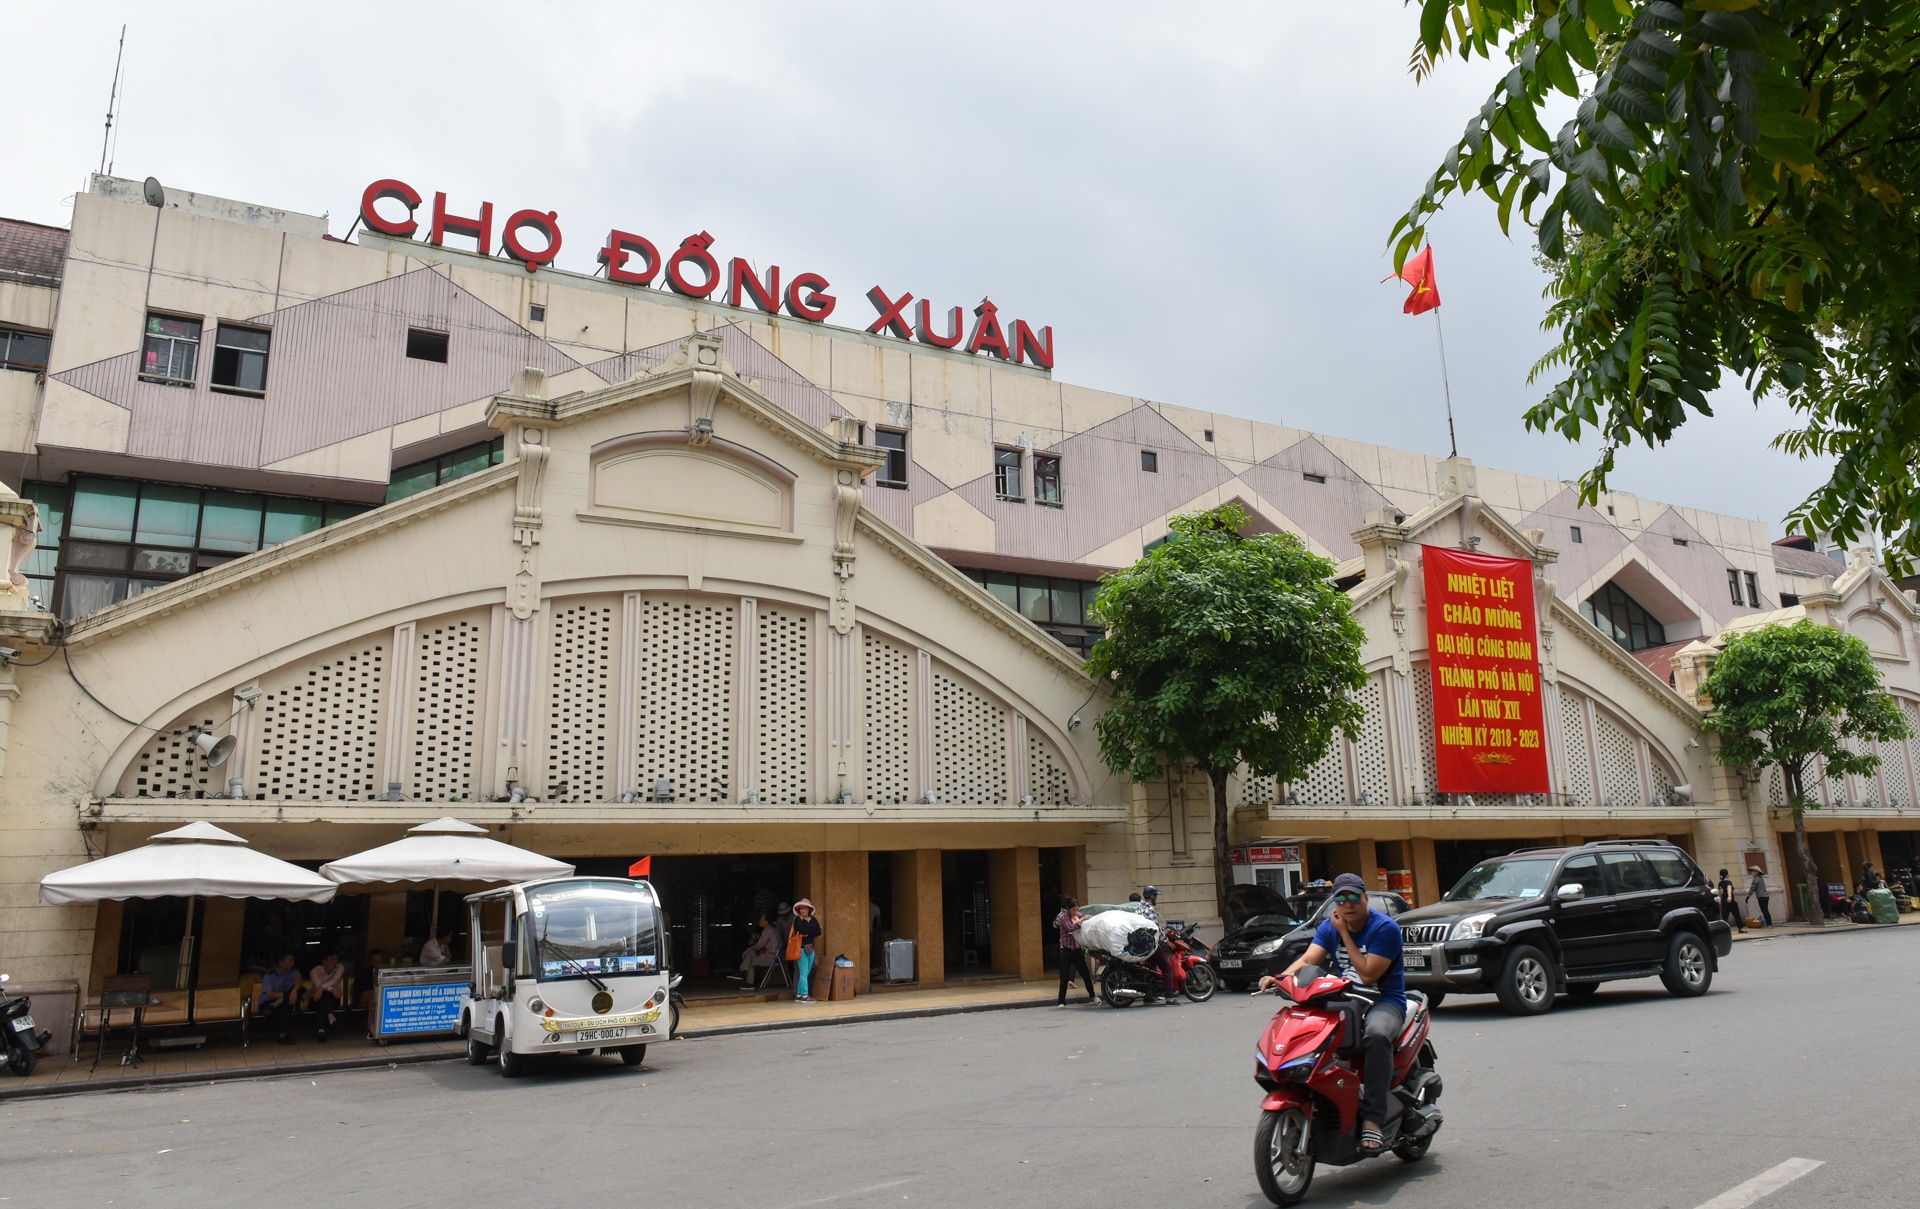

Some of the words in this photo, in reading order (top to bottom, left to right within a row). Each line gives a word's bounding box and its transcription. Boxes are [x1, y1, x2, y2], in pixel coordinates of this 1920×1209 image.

[361, 178, 563, 272] CHỢ
[598, 229, 838, 320] ĐỒNG
[865, 284, 1055, 369] XUÂN
[1447, 573, 1486, 599] NHIỆT
[1489, 576, 1514, 602] LIỆT
[1443, 601, 1482, 626] CHÀO
[1484, 605, 1522, 630] MỪNG
[1436, 633, 1455, 658] ĐẠI
[1456, 632, 1474, 659] HỘI
[1477, 635, 1505, 658] CÔNG
[1506, 638, 1532, 661] ĐOÀN
[1439, 664, 1475, 688] THÀNH
[1477, 664, 1500, 690] PHỐ
[1501, 668, 1517, 692] HÀ
[1518, 670, 1534, 696] NỘI
[1457, 692, 1480, 718] LẦN
[1481, 695, 1501, 719] THỨ
[1502, 700, 1522, 720] XVI
[1441, 723, 1473, 750] NHIỆM
[1475, 724, 1488, 746] KỲ
[1490, 727, 1512, 747] 2018
[1519, 729, 1540, 749] 2023
[580, 1028, 624, 1041] 29HC-000.47
